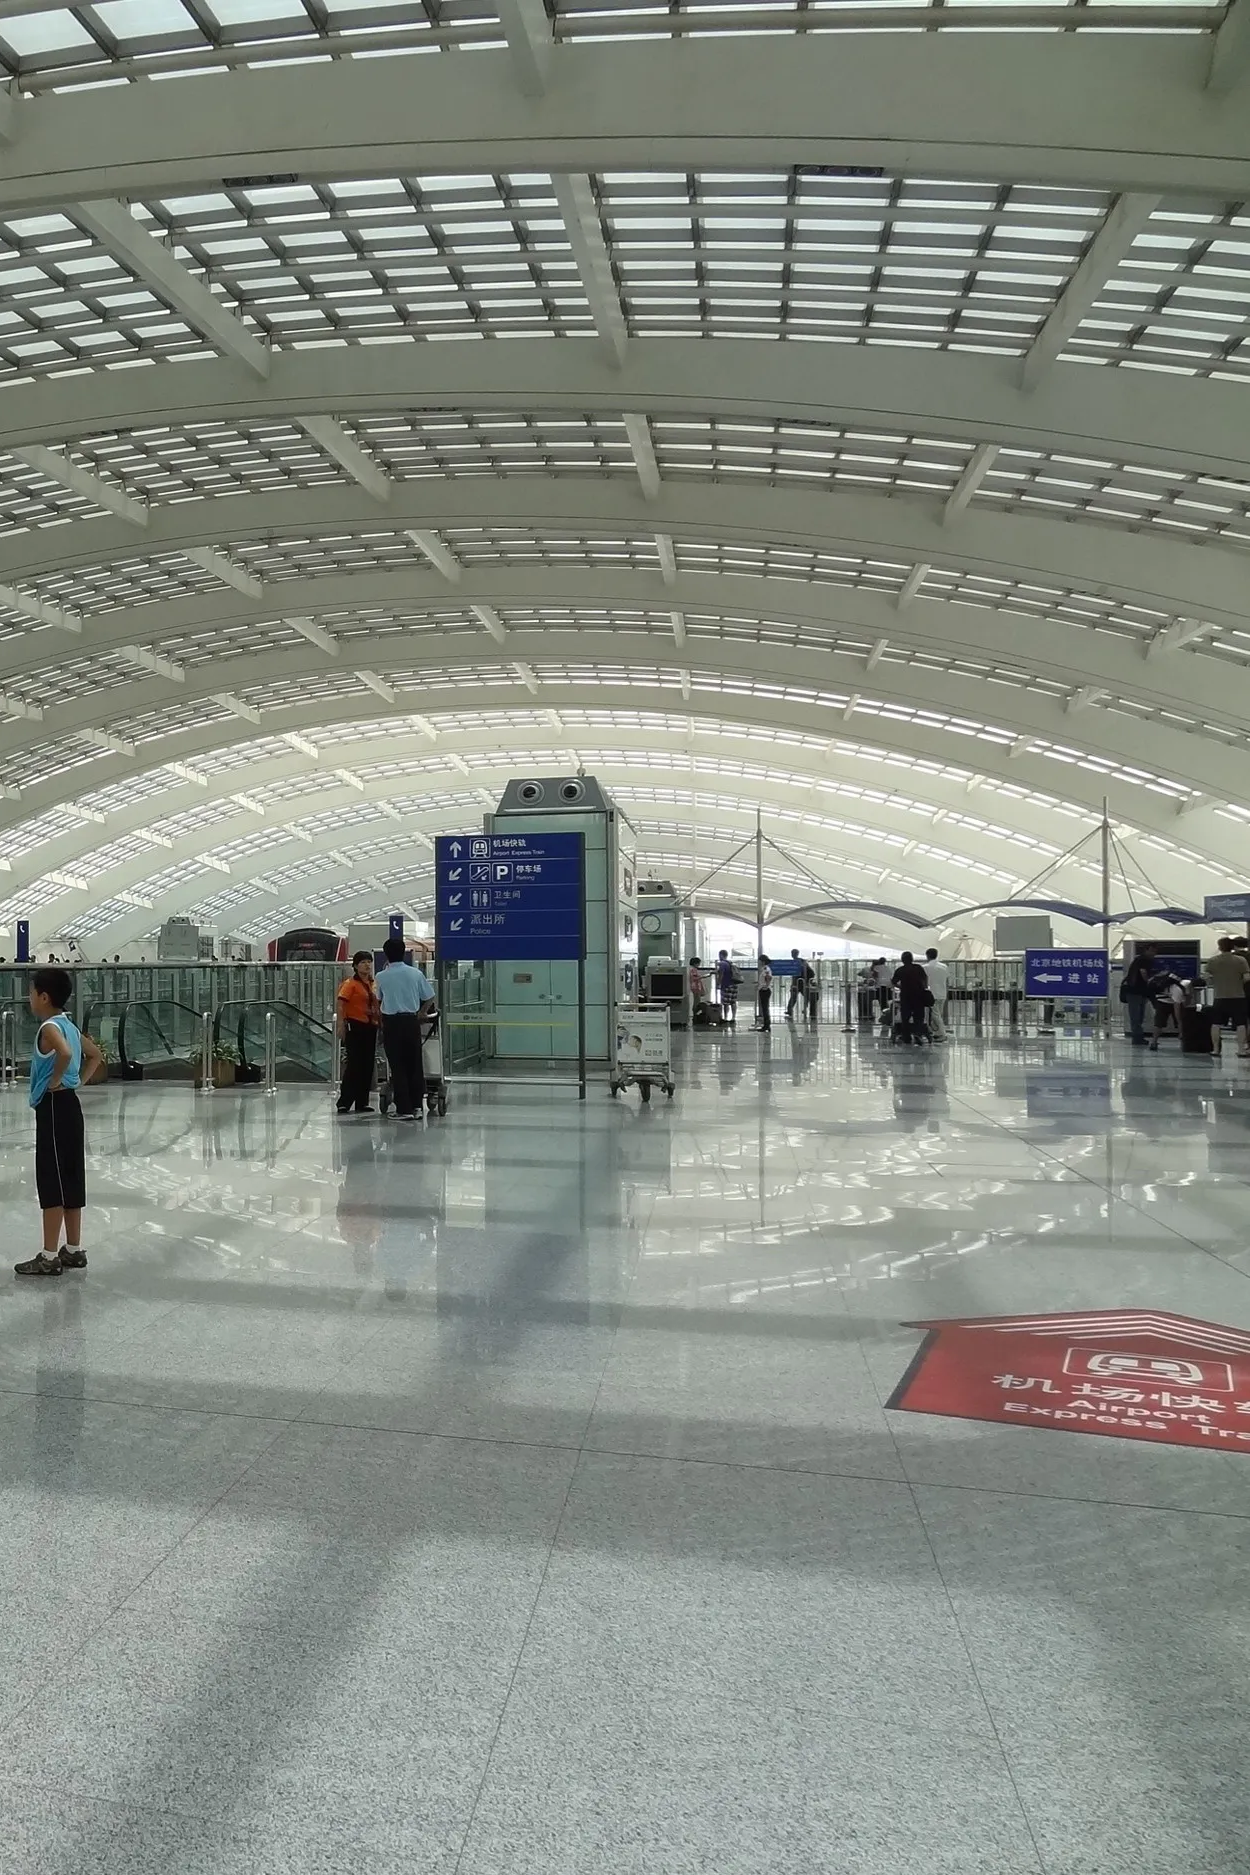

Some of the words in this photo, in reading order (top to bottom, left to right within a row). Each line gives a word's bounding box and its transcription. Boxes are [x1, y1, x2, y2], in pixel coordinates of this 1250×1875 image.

[493, 839, 526, 848] 机场快轨
[496, 865, 508, 880] P
[516, 864, 542, 873] 停车场
[494, 890, 521, 899] 卫生间
[470, 913, 506, 925] 派出所
[1031, 958, 1105, 968] 北京地铁机场线
[1067, 973, 1099, 984] 进站
[992, 1374, 1250, 1414] 机场快
[1003, 1402, 1168, 1430] Express
[1066, 1400, 1211, 1424] Airport
